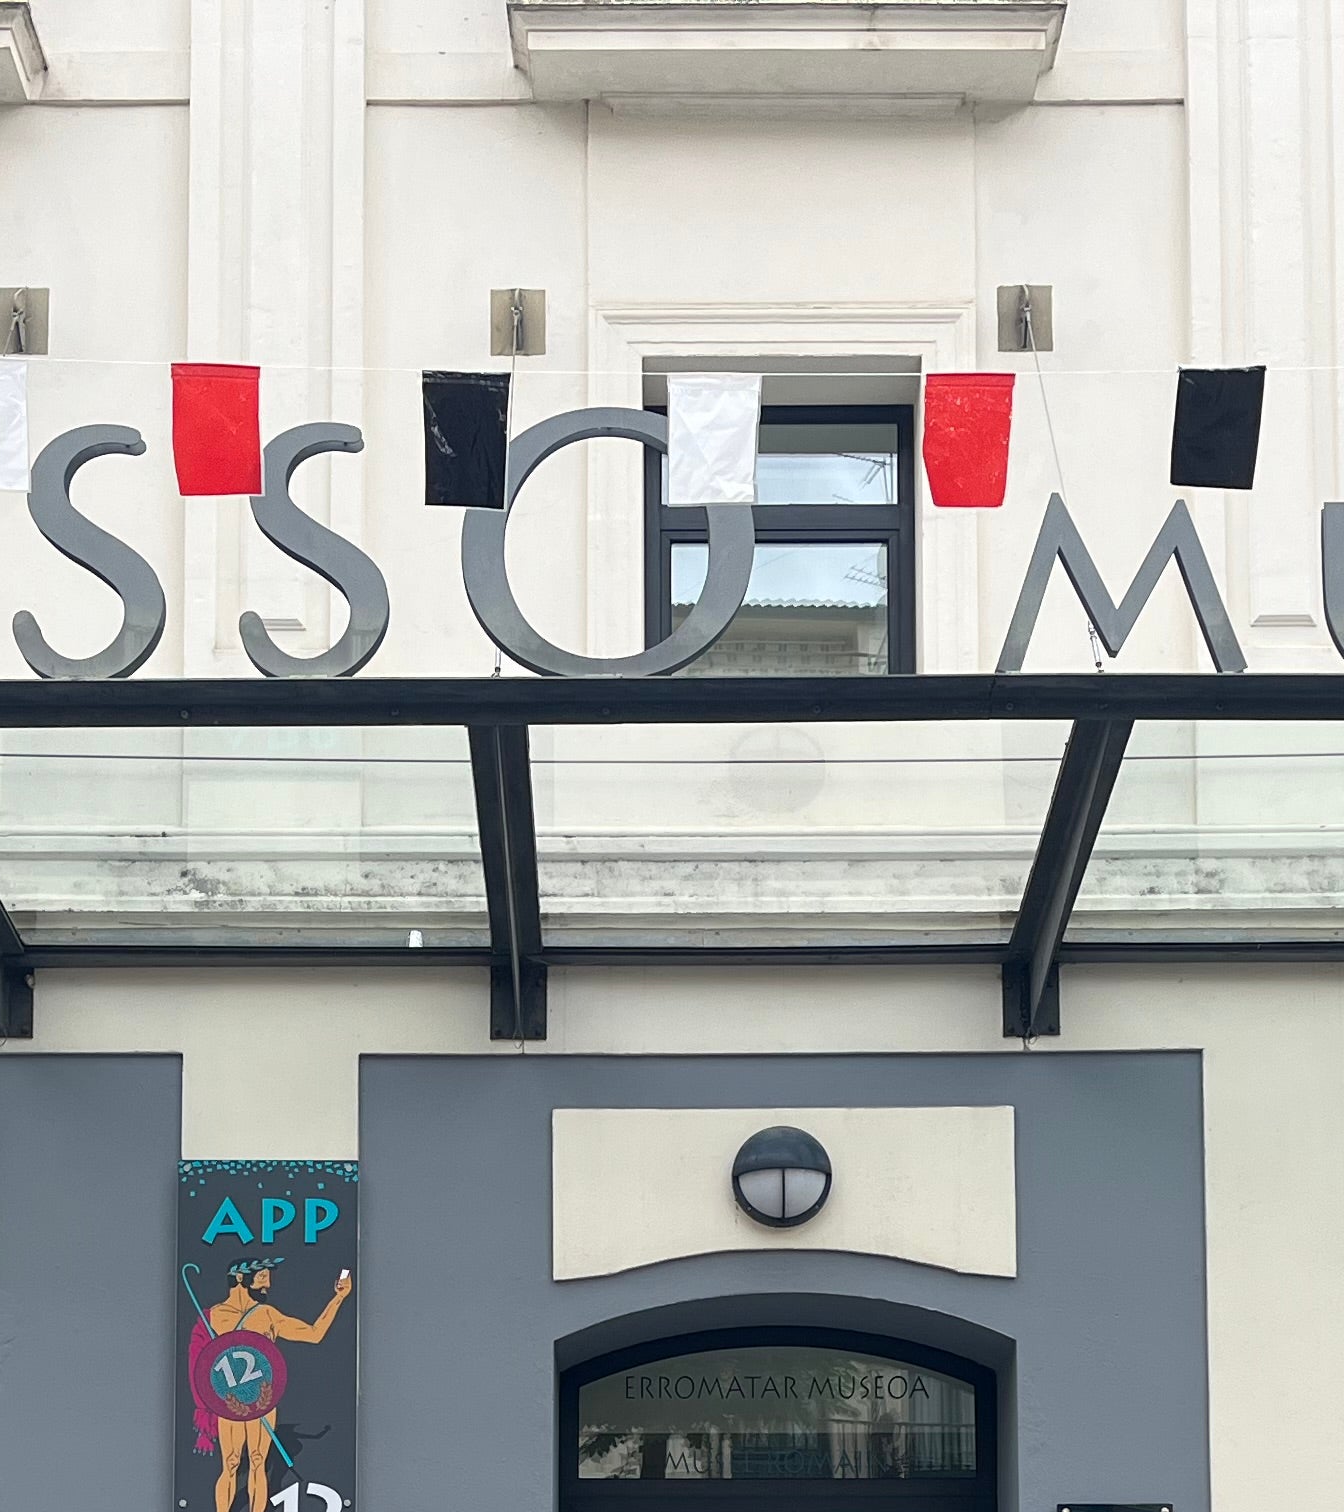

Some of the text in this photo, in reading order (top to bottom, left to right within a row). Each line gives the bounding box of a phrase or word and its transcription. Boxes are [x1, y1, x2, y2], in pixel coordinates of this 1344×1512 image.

[202, 1196, 340, 1244] APP
[214, 1351, 263, 1388] 12
[625, 1376, 930, 1399] ERROMATAR MUSEOA
